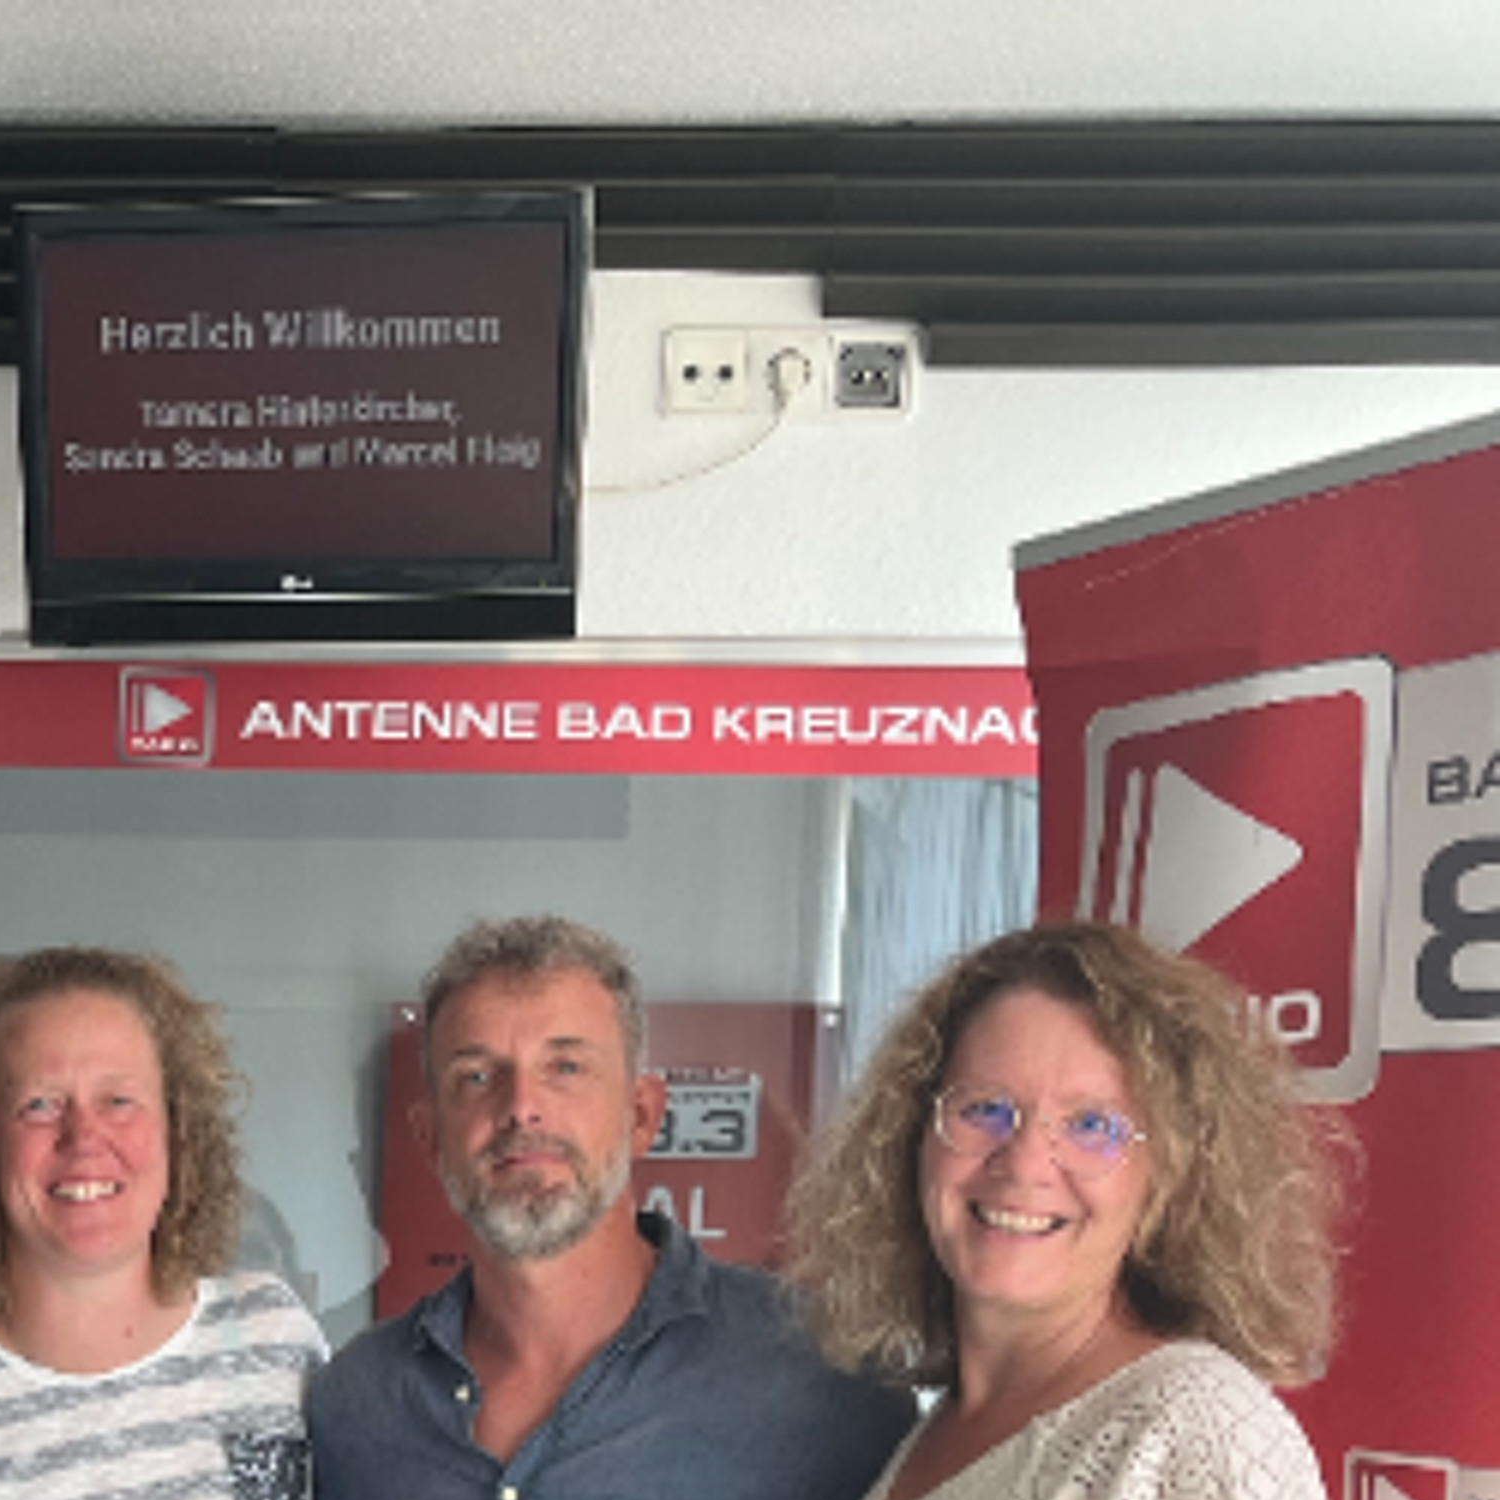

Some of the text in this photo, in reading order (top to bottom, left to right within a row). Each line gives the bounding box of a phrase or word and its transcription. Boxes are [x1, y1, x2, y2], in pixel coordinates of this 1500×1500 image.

[100, 309, 501, 354] Herzlich Willkommen
[239, 699, 539, 741] ANTENNE
[556, 702, 692, 742] BAD
